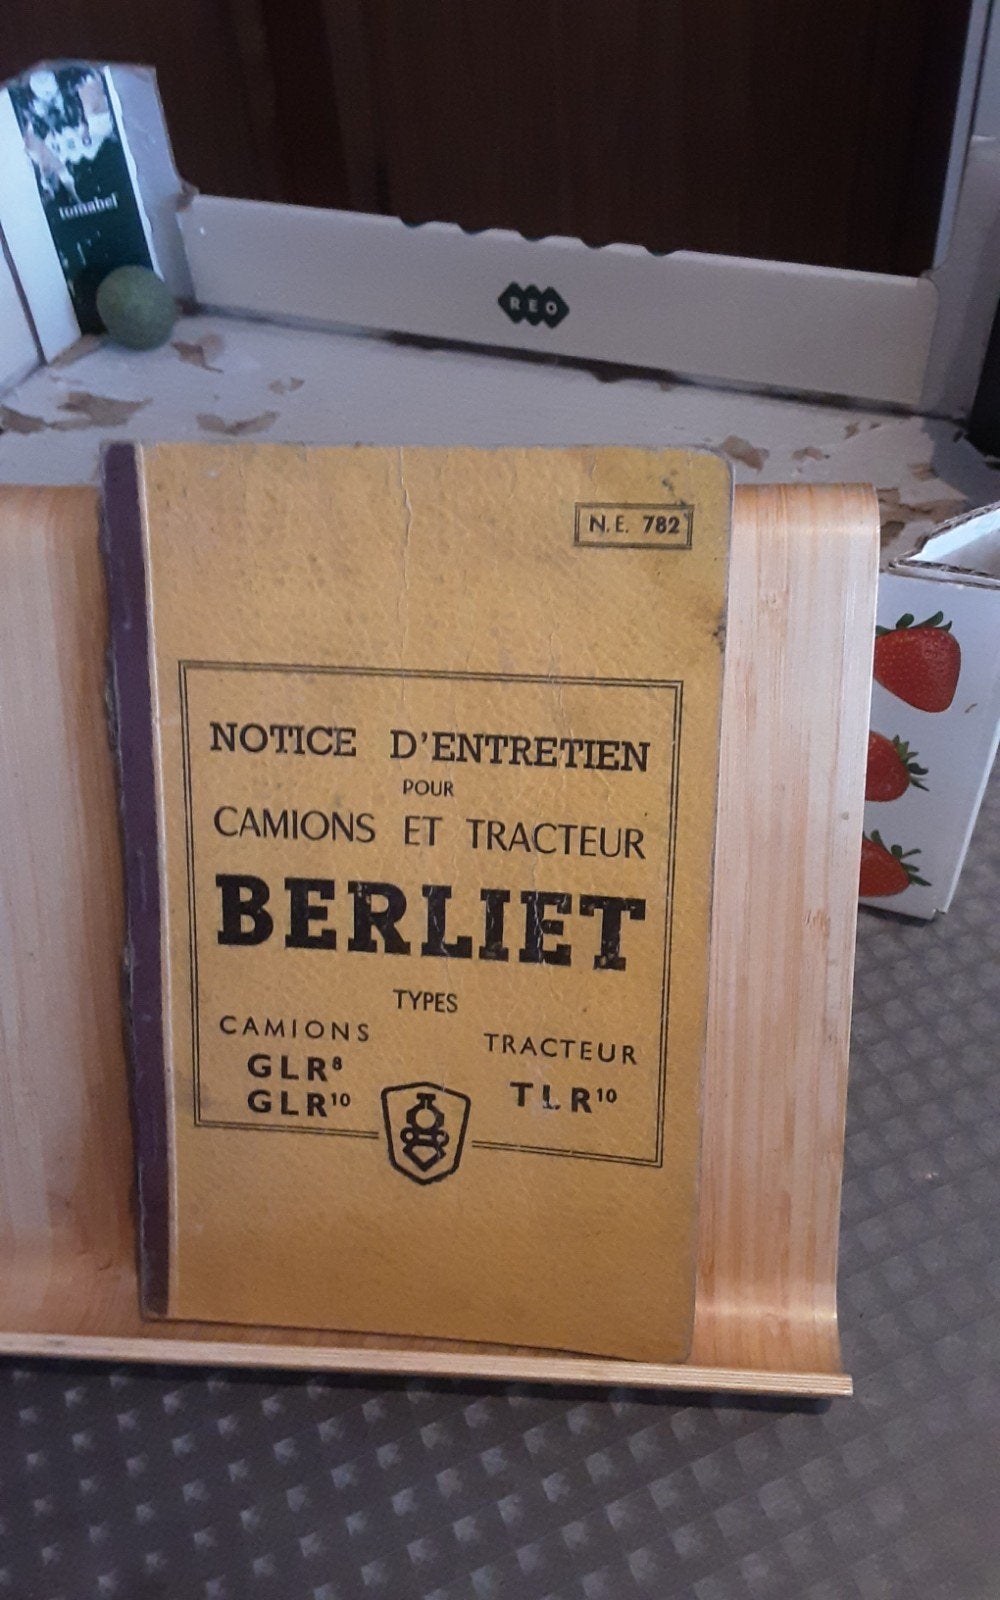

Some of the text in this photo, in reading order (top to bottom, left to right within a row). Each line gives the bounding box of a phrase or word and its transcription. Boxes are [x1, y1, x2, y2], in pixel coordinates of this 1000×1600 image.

[510, 296, 558, 316] REO
[643, 515, 680, 534] 782
[209, 721, 651, 772] NOTICE D'ENTRETIEN
[403, 779, 454, 797] POUR
[213, 805, 646, 860] CAMIONS ET TRACTEUR
[215, 873, 647, 971] BERLIET
[393, 989, 459, 1013] TYPES
[219, 1015, 370, 1042] CAMIONS
[484, 1033, 637, 1066] TRACTEUR
